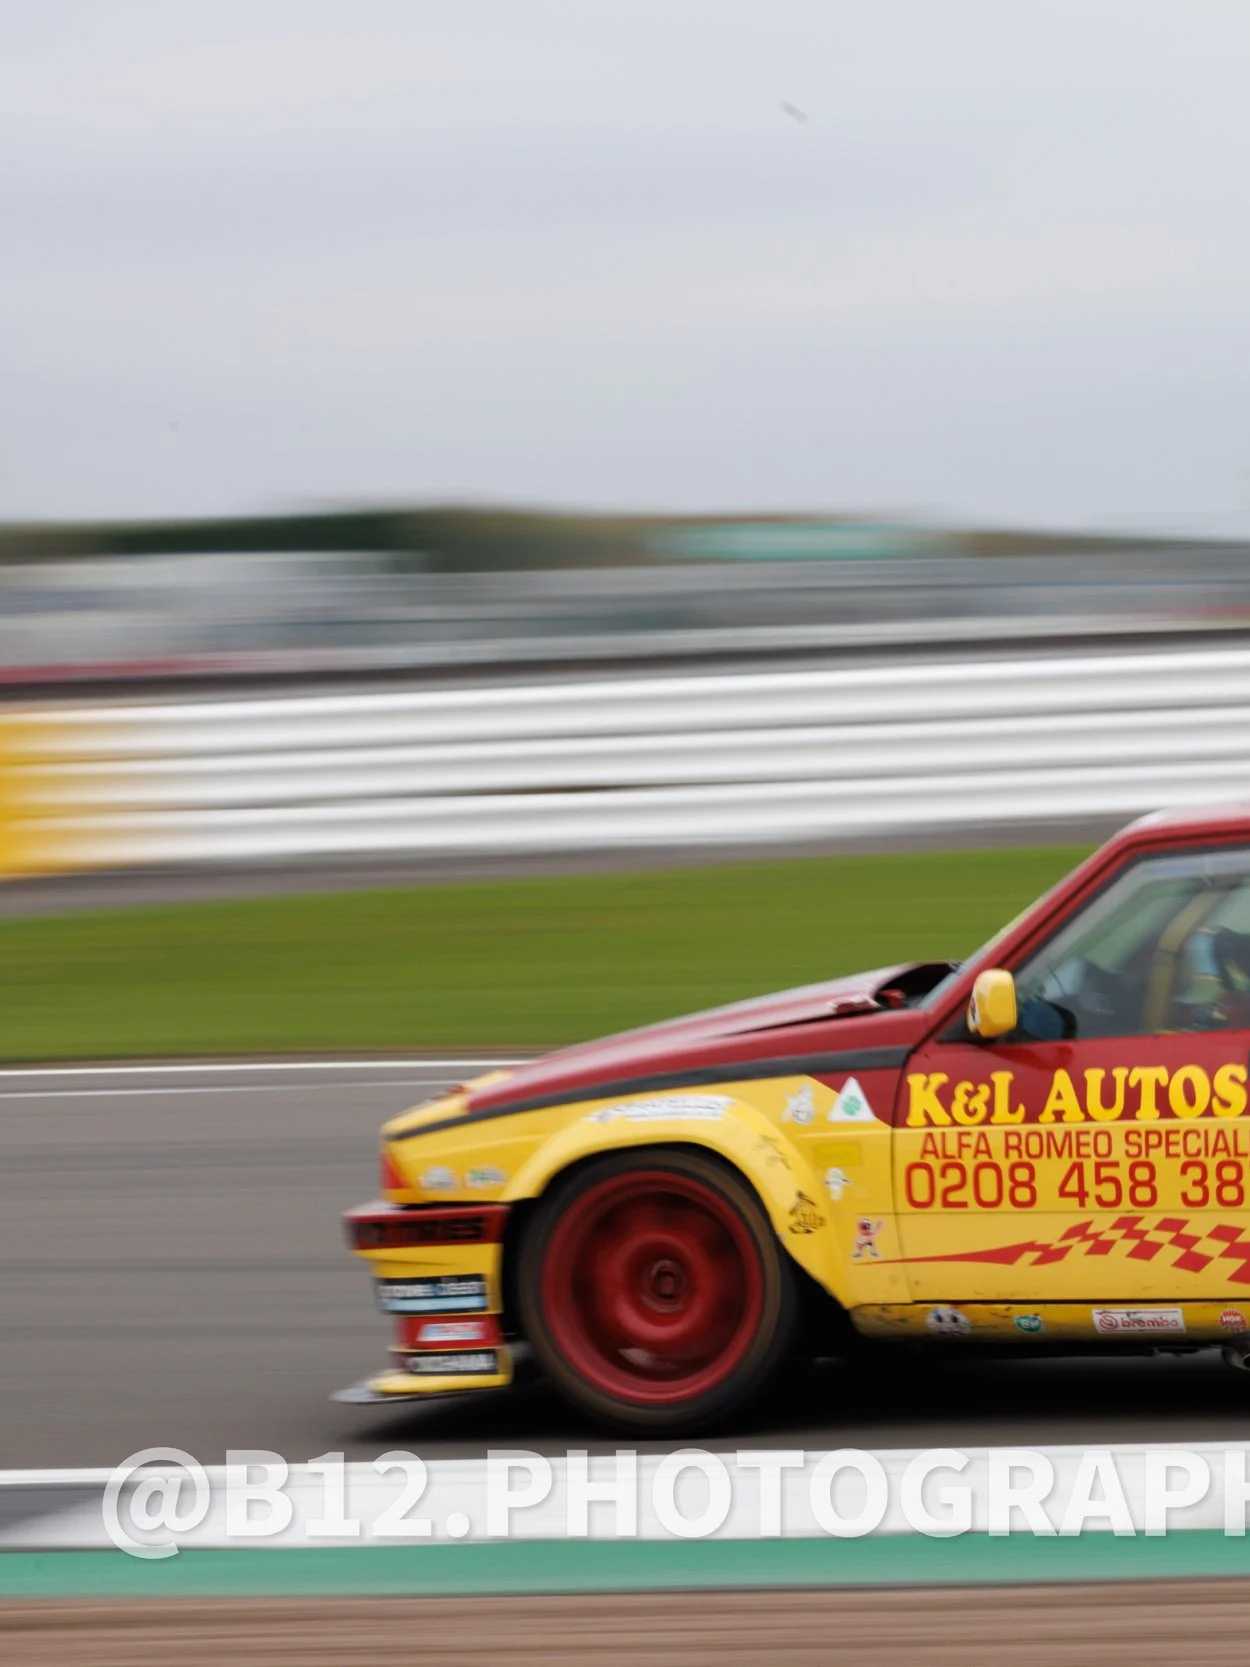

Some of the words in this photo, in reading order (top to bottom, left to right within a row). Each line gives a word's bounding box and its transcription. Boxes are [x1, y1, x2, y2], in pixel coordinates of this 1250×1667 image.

[906, 1070, 1026, 1127] K&L
[1039, 1064, 1248, 1124] AUTOS
[920, 1131, 993, 1161] ALFA
[1004, 1130, 1113, 1160] ROMEO
[905, 1161, 1038, 1209] 0208
[1057, 1160, 1159, 1208] 458
[1120, 1316, 1179, 1328] brembo
